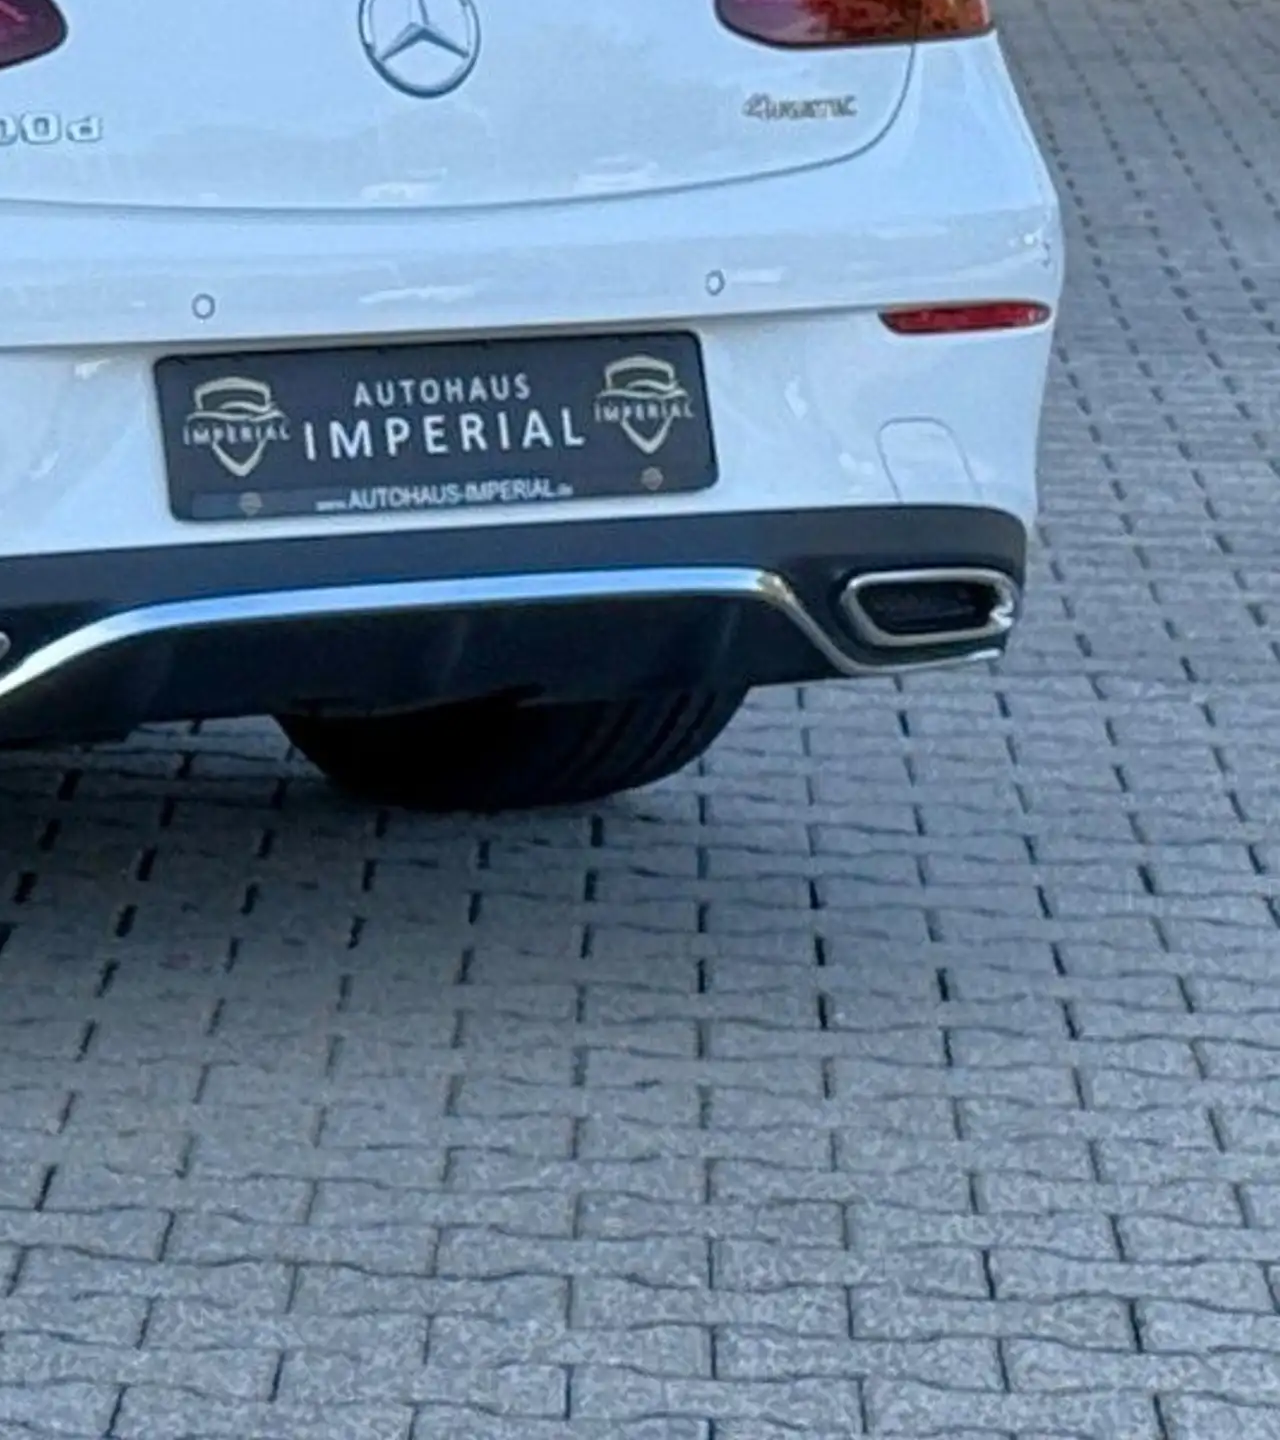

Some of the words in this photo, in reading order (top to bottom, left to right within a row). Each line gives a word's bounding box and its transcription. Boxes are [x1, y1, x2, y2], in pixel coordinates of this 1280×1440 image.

[353, 372, 532, 408] AUTOHAUS
[593, 402, 694, 423] IMPERIAL
[183, 424, 291, 446] IMPERIAL
[303, 407, 587, 461] IMPERIAL
